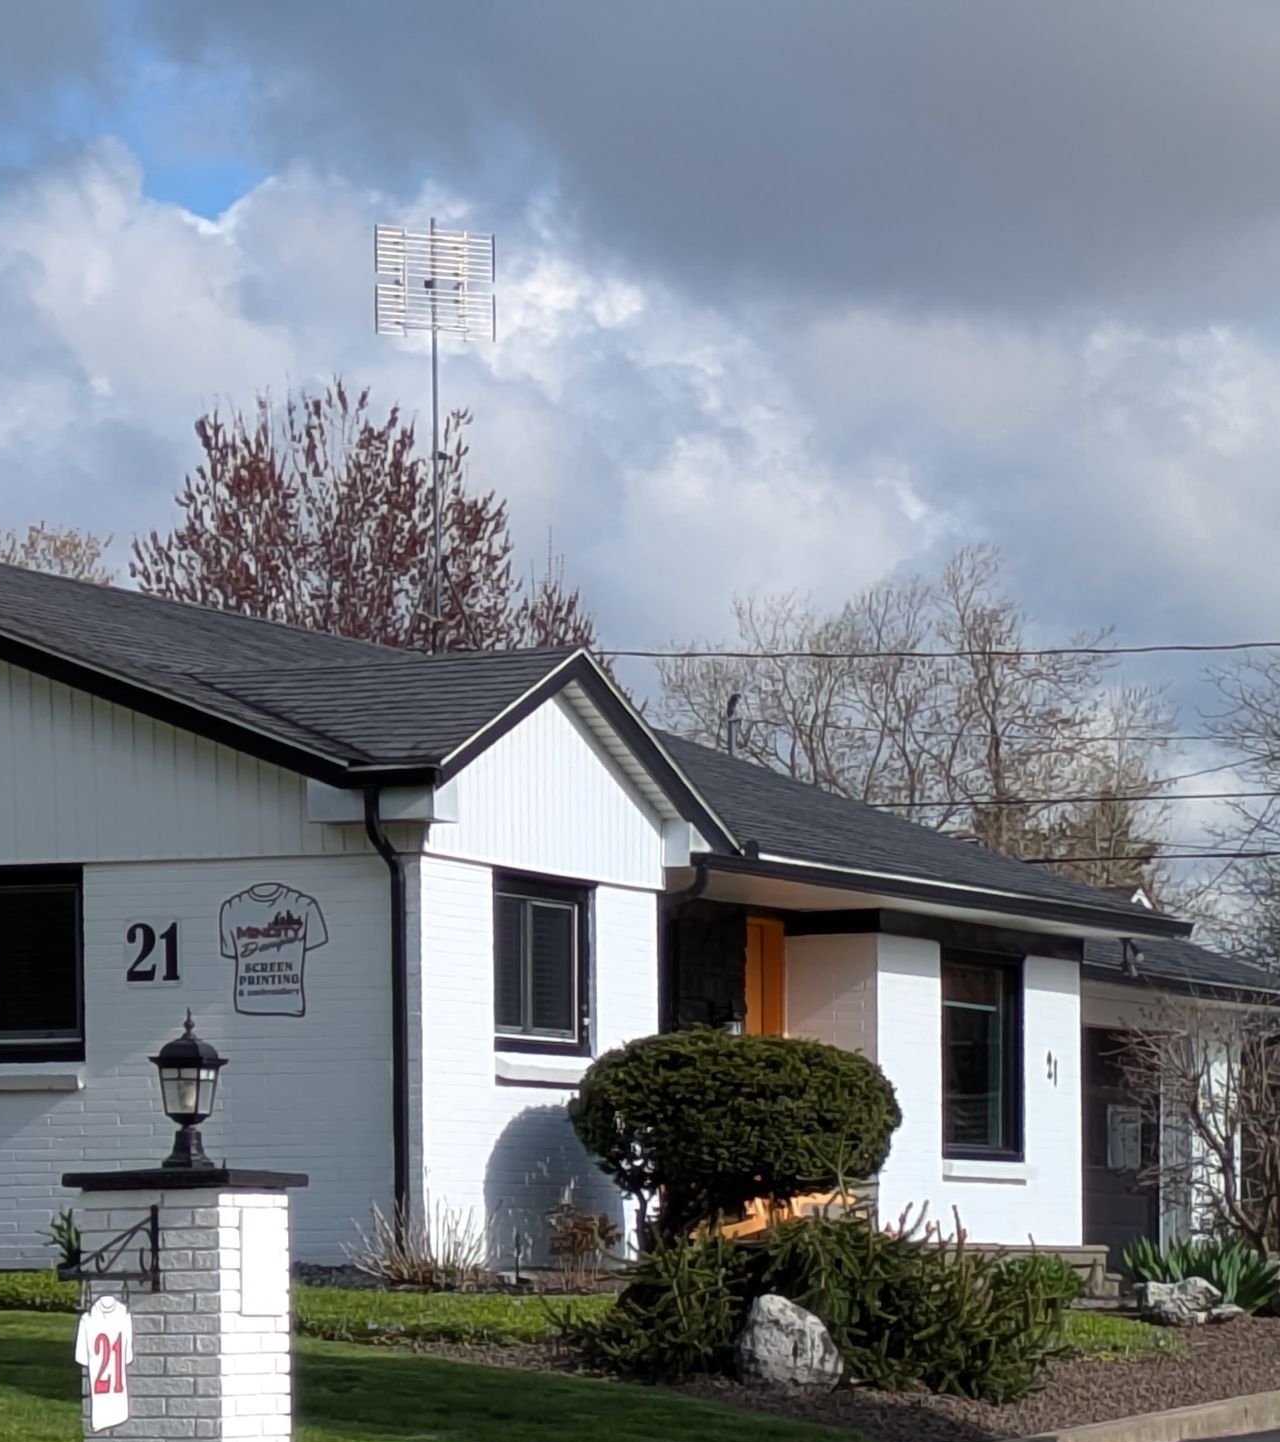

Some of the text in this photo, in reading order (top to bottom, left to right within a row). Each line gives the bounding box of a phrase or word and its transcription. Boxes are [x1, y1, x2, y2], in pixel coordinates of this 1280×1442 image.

[126, 921, 180, 982] 21
[245, 962, 293, 973] SCREEN
[239, 974, 300, 986] PRINTING
[94, 1332, 124, 1395] 21
